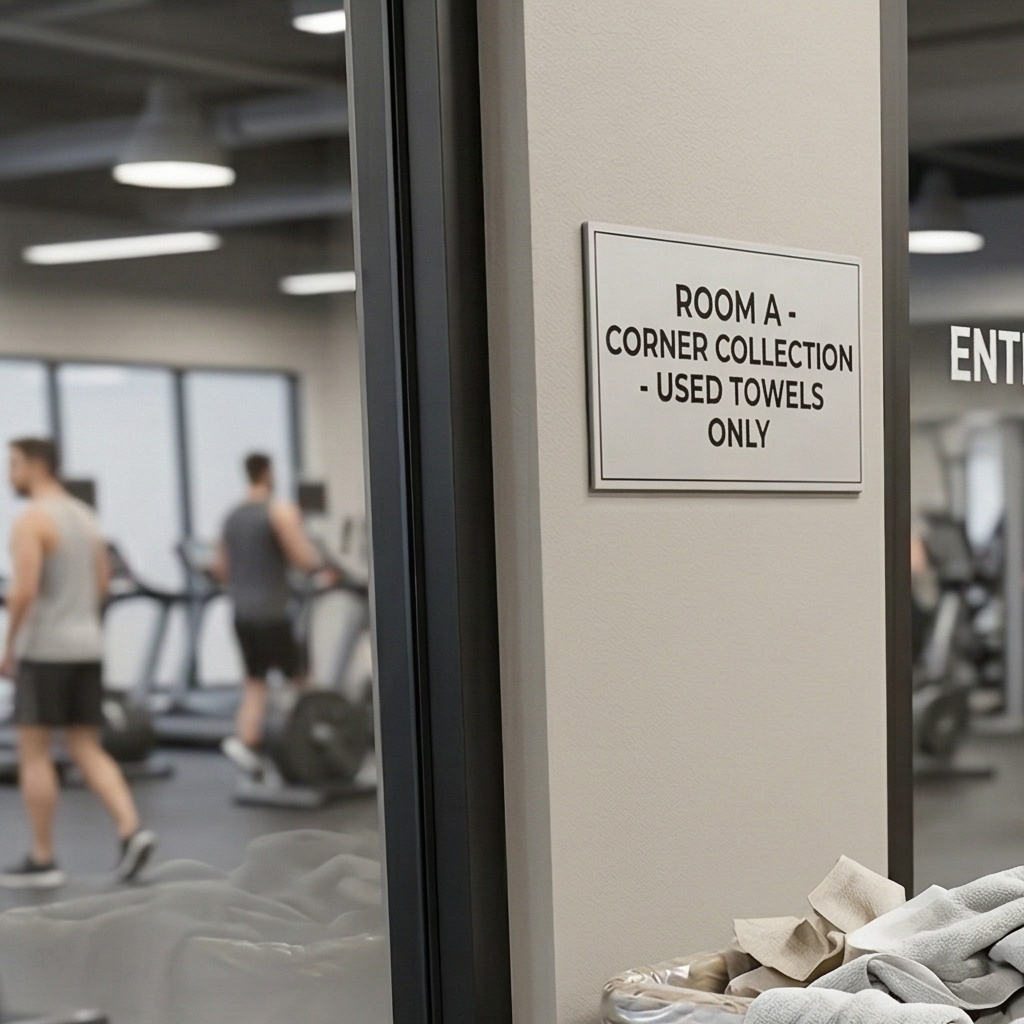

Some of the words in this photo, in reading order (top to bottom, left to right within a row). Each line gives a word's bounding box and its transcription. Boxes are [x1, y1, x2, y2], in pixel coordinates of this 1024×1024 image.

[675, 283, 756, 325] ROOM
[763, 293, 782, 327] A
[605, 324, 708, 361] CORNER
[715, 334, 853, 372] COLLECTION
[656, 371, 723, 404] USED
[729, 376, 824, 410] TOWELS
[708, 417, 770, 449] ONLY
